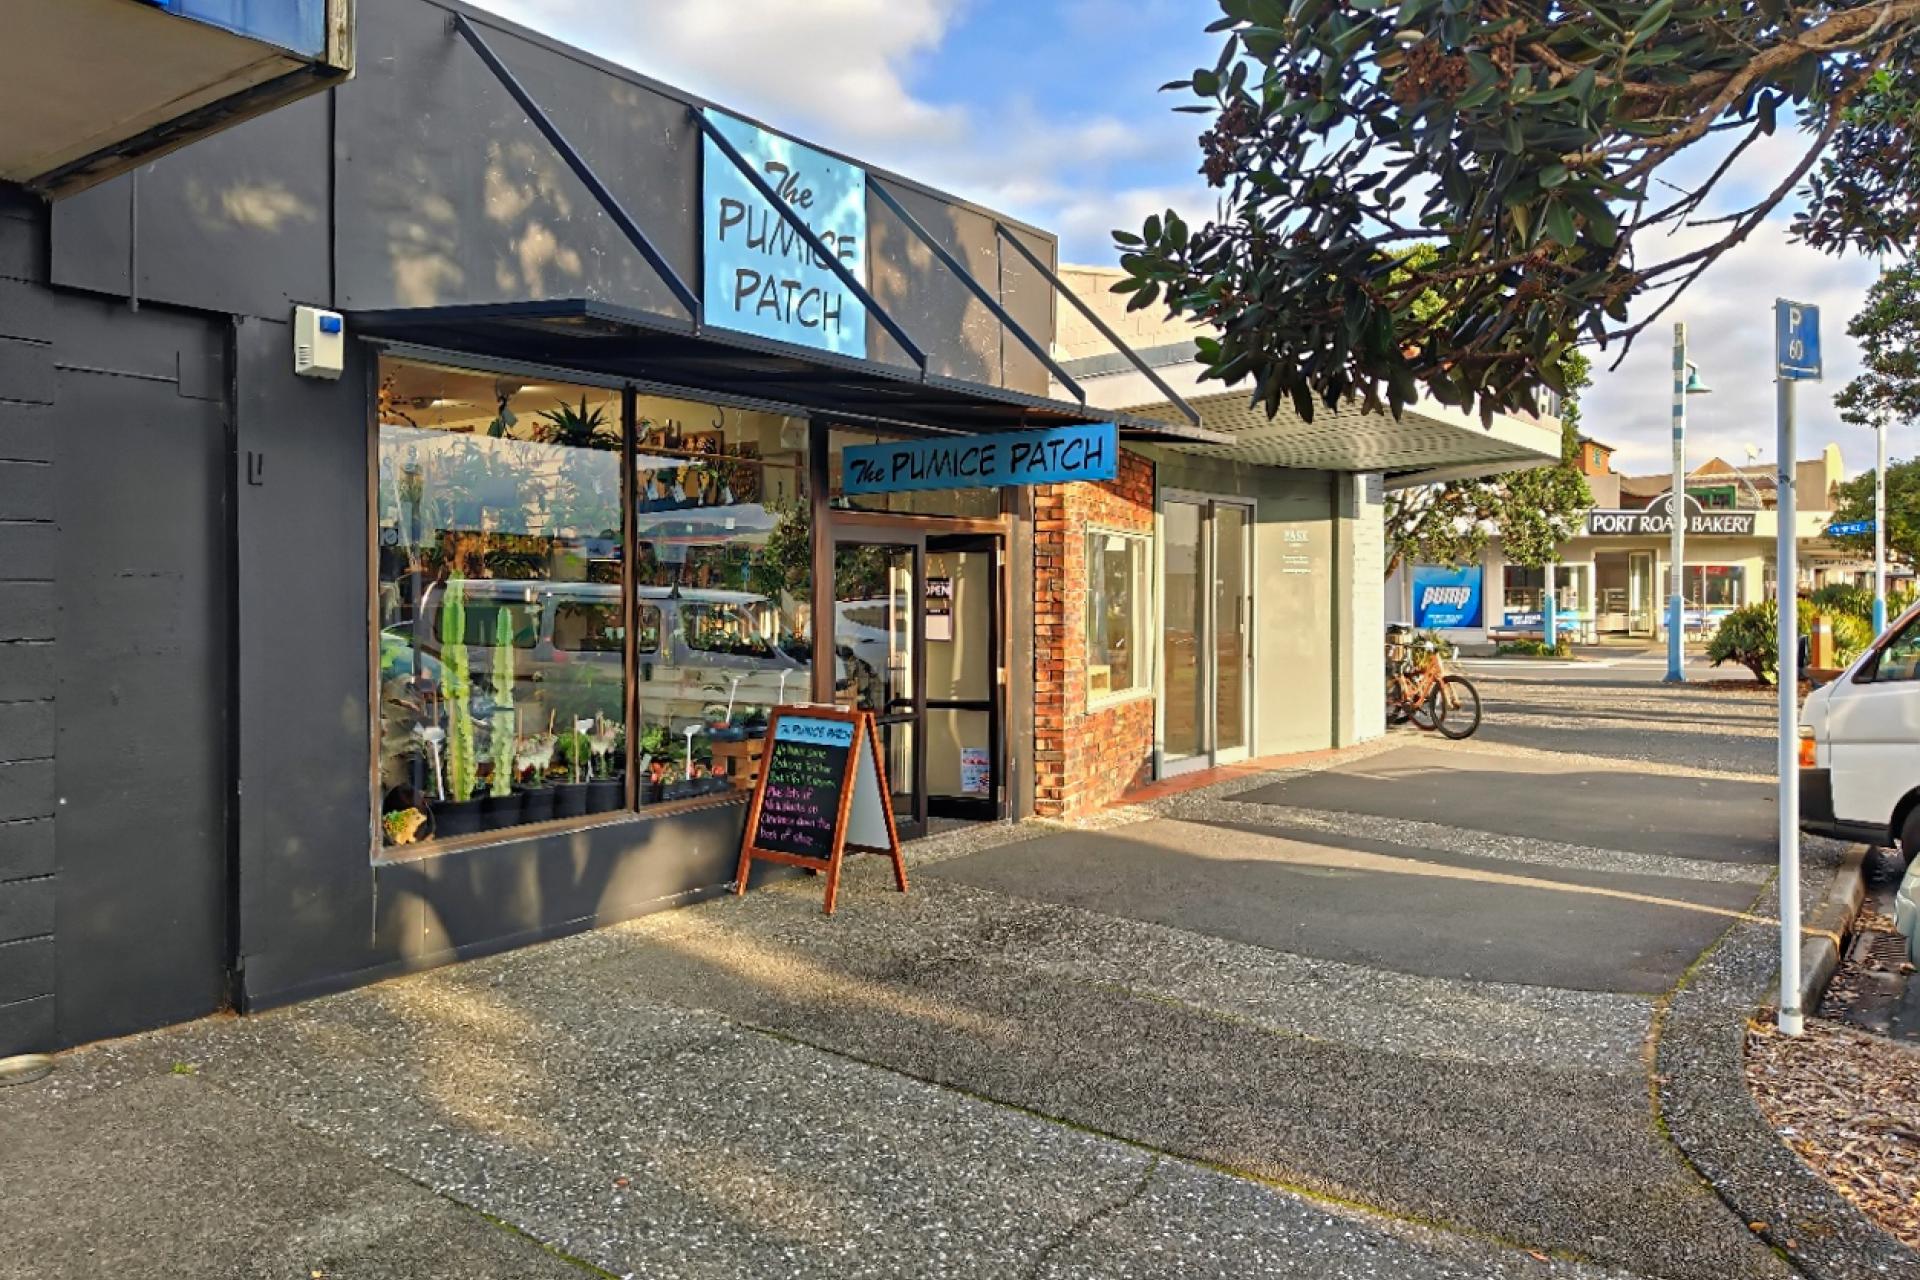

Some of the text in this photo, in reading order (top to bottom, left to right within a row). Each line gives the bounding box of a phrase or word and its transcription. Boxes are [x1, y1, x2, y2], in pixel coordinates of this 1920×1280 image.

[764, 161, 813, 209] The
[718, 197, 857, 275] PUMICE
[734, 268, 842, 335] PATCH
[1789, 306, 1801, 334] P
[850, 436, 1104, 485] The PUMICE PATCH
[1593, 515, 1752, 533] PORT ROA BAKERY
[1421, 586, 1471, 610] pump
